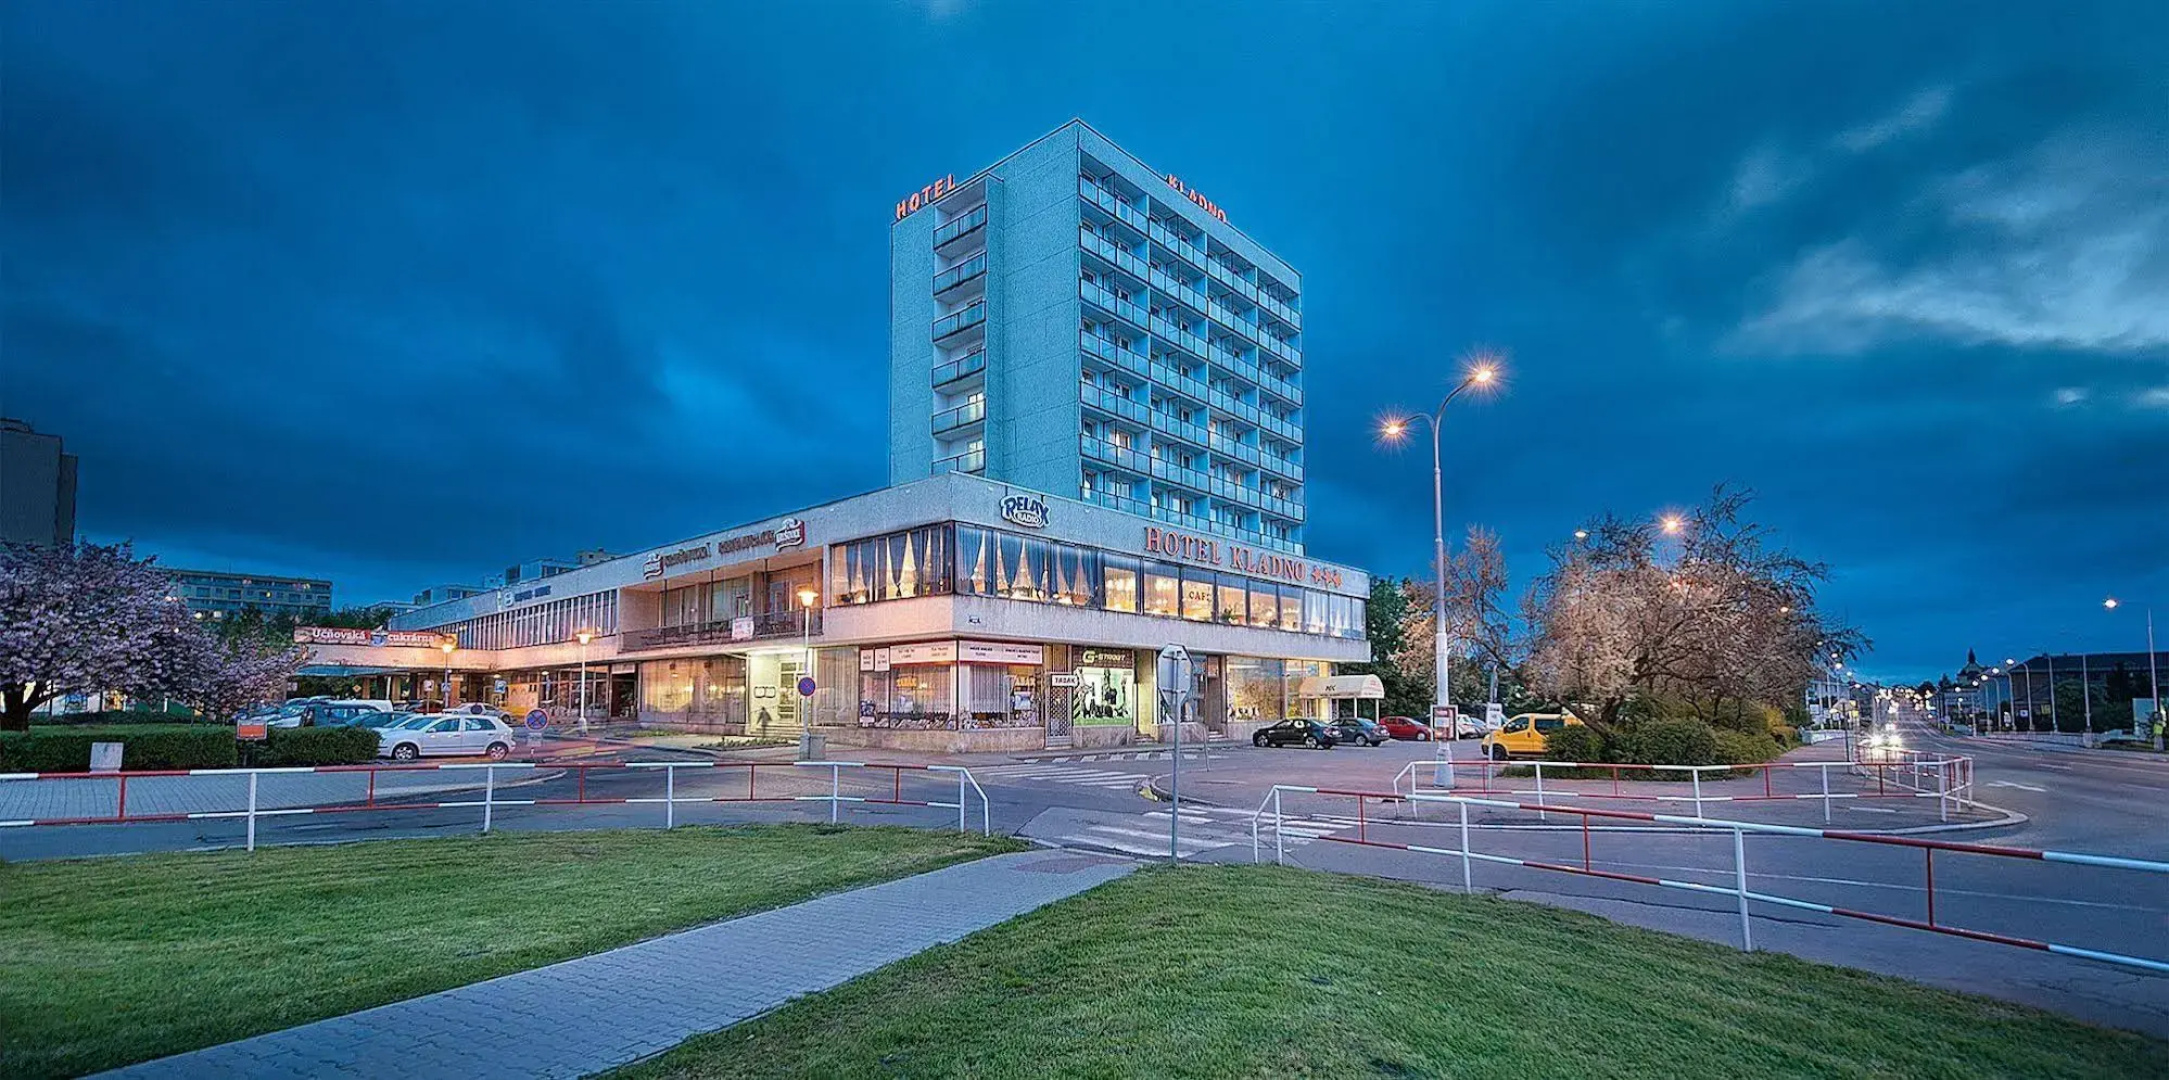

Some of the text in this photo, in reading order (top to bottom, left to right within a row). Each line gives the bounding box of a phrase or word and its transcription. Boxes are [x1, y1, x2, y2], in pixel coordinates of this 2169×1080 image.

[896, 173, 955, 220] HOTEL
[1168, 174, 1226, 222] KLADNO
[1003, 496, 1050, 525] RELAX
[1016, 512, 1040, 523] RADIO
[1144, 527, 1307, 582] HOTEL KLADNO
